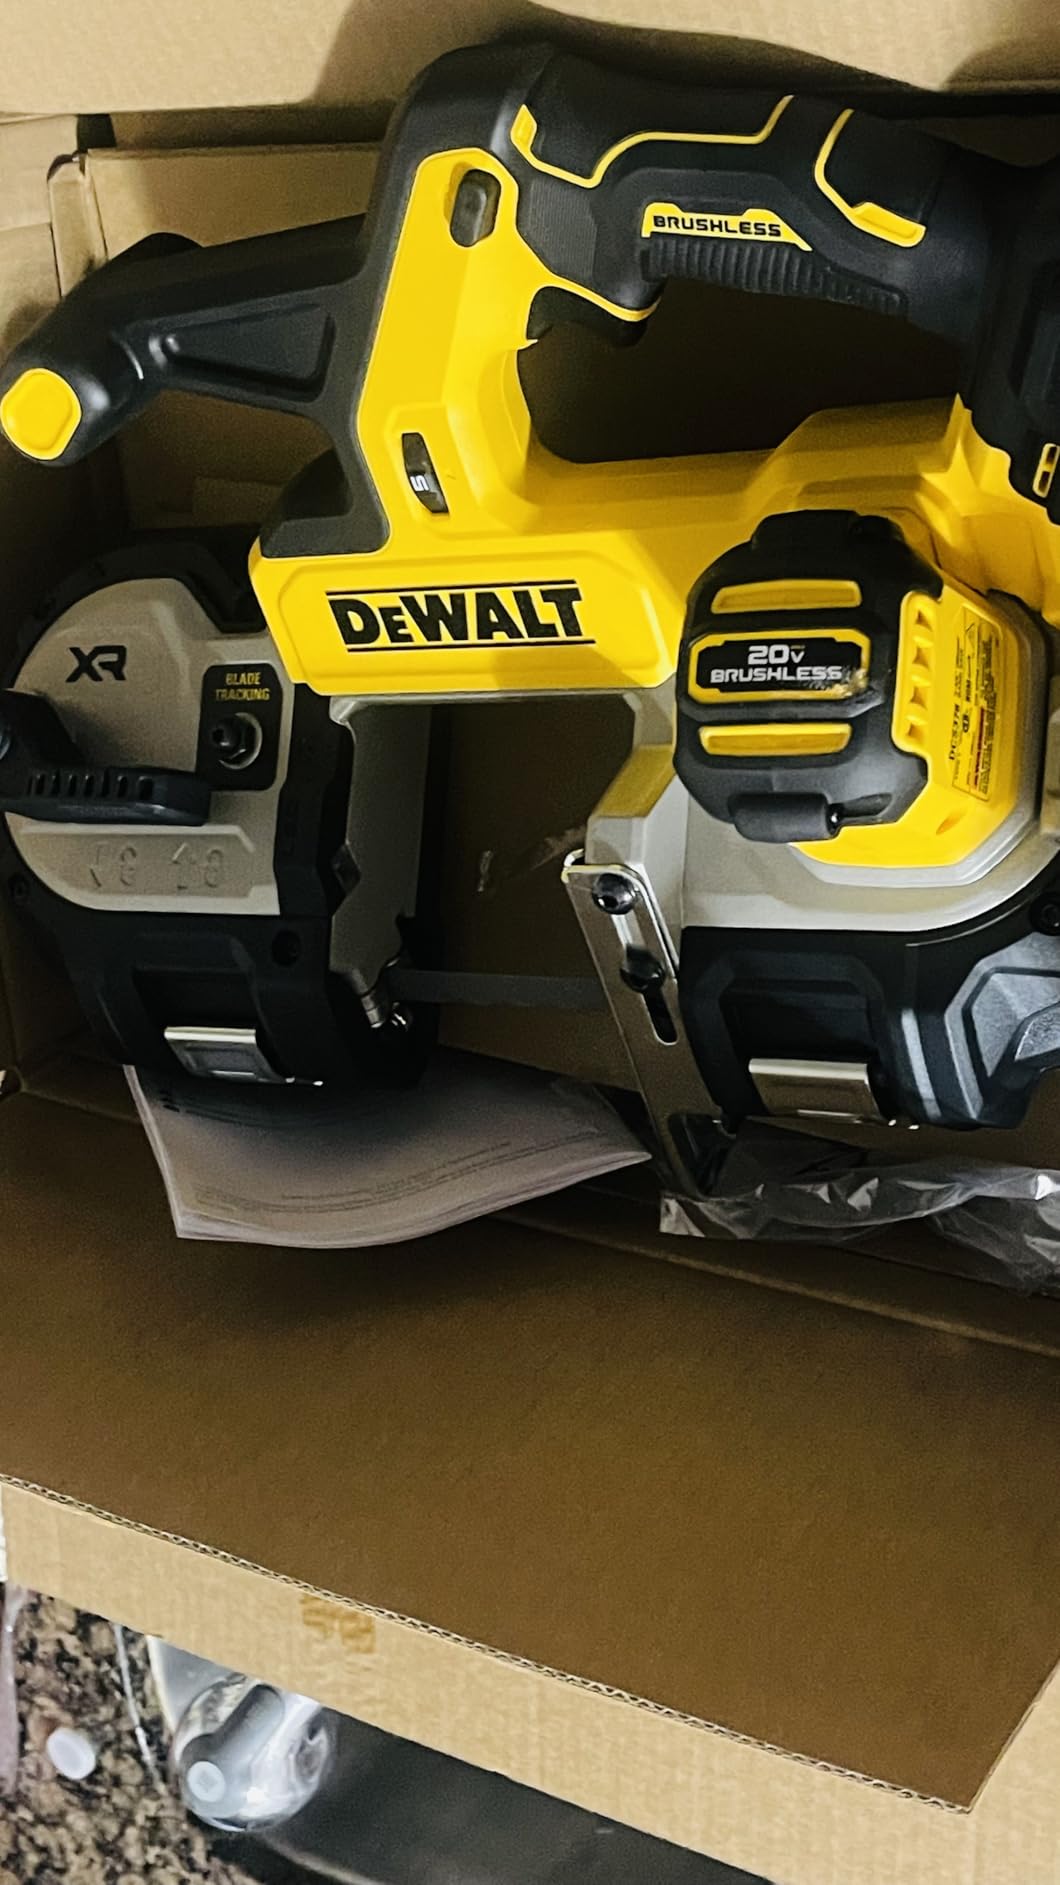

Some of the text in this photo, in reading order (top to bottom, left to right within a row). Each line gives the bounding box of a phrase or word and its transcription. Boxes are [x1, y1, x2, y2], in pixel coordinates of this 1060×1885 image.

[653, 215, 781, 237] BRUSHLESS
[329, 587, 583, 645] DEWALT
[65, 645, 127, 682] XR
[226, 671, 261, 686] BLADE
[710, 666, 843, 683] BRUSHLESS
[216, 687, 270, 701] TRACKING
